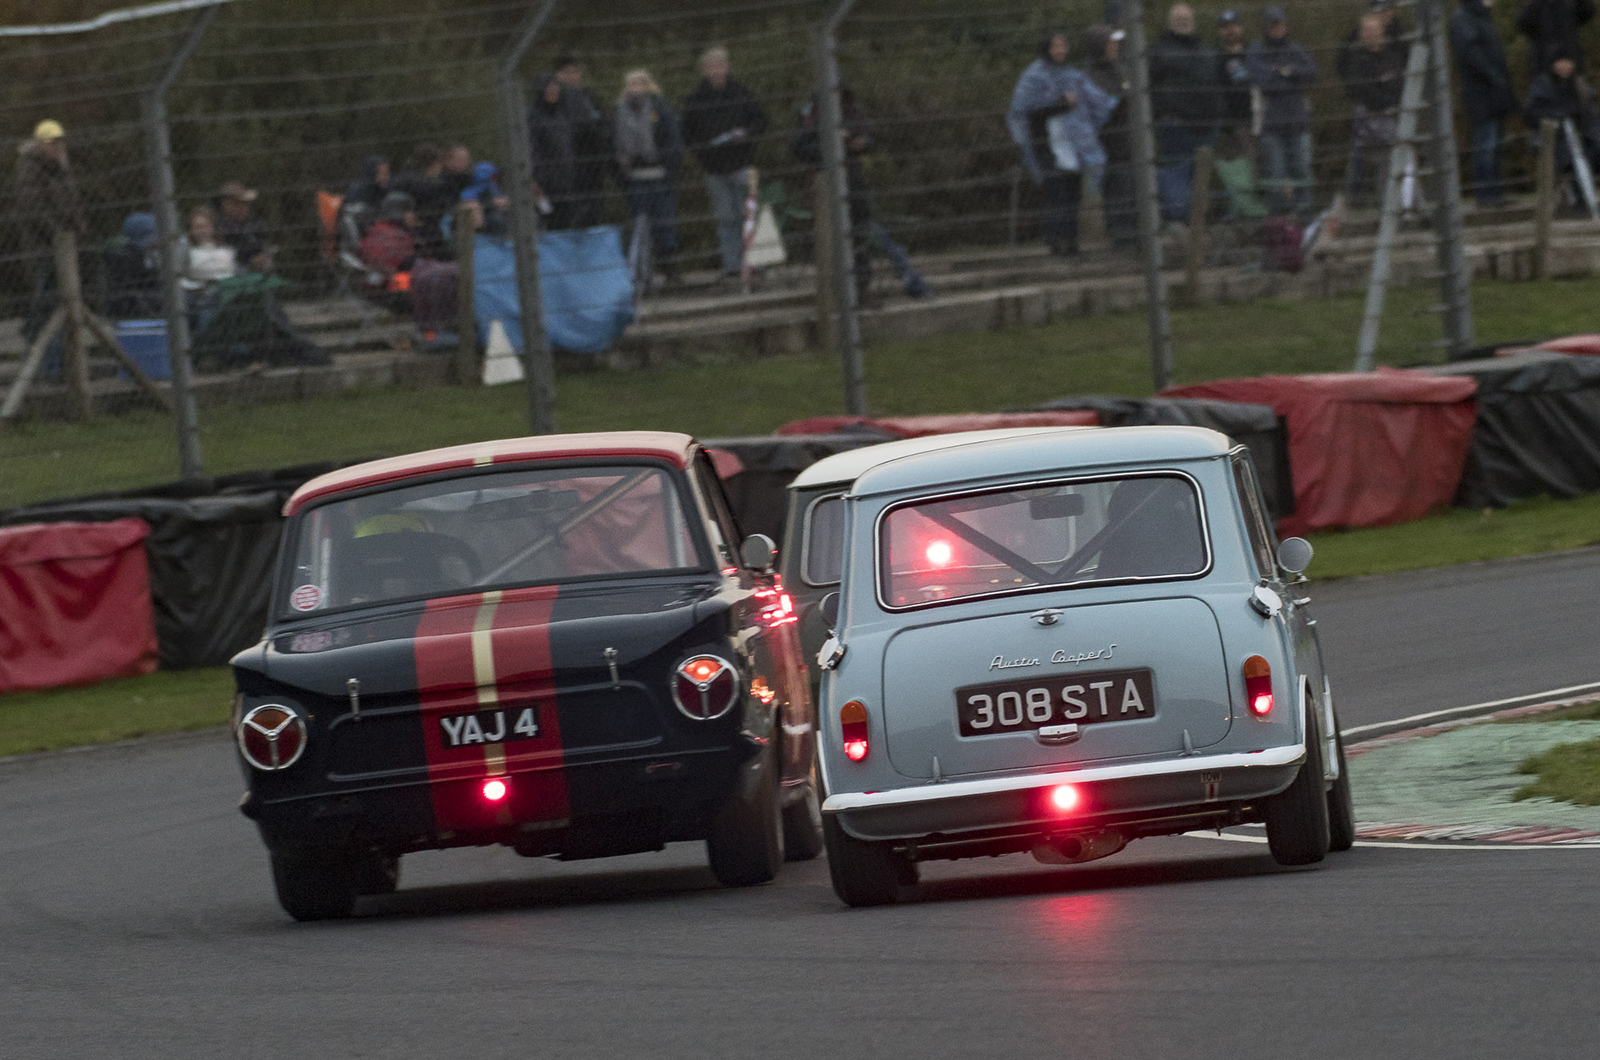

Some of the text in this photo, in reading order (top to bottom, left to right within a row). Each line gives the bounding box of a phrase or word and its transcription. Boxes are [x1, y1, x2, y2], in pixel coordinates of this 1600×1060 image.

[989, 655, 1041, 671] Austin
[968, 678, 1145, 729] 308 STA
[440, 708, 538, 746] YAJ 4
[1201, 771, 1220, 782] TOW
